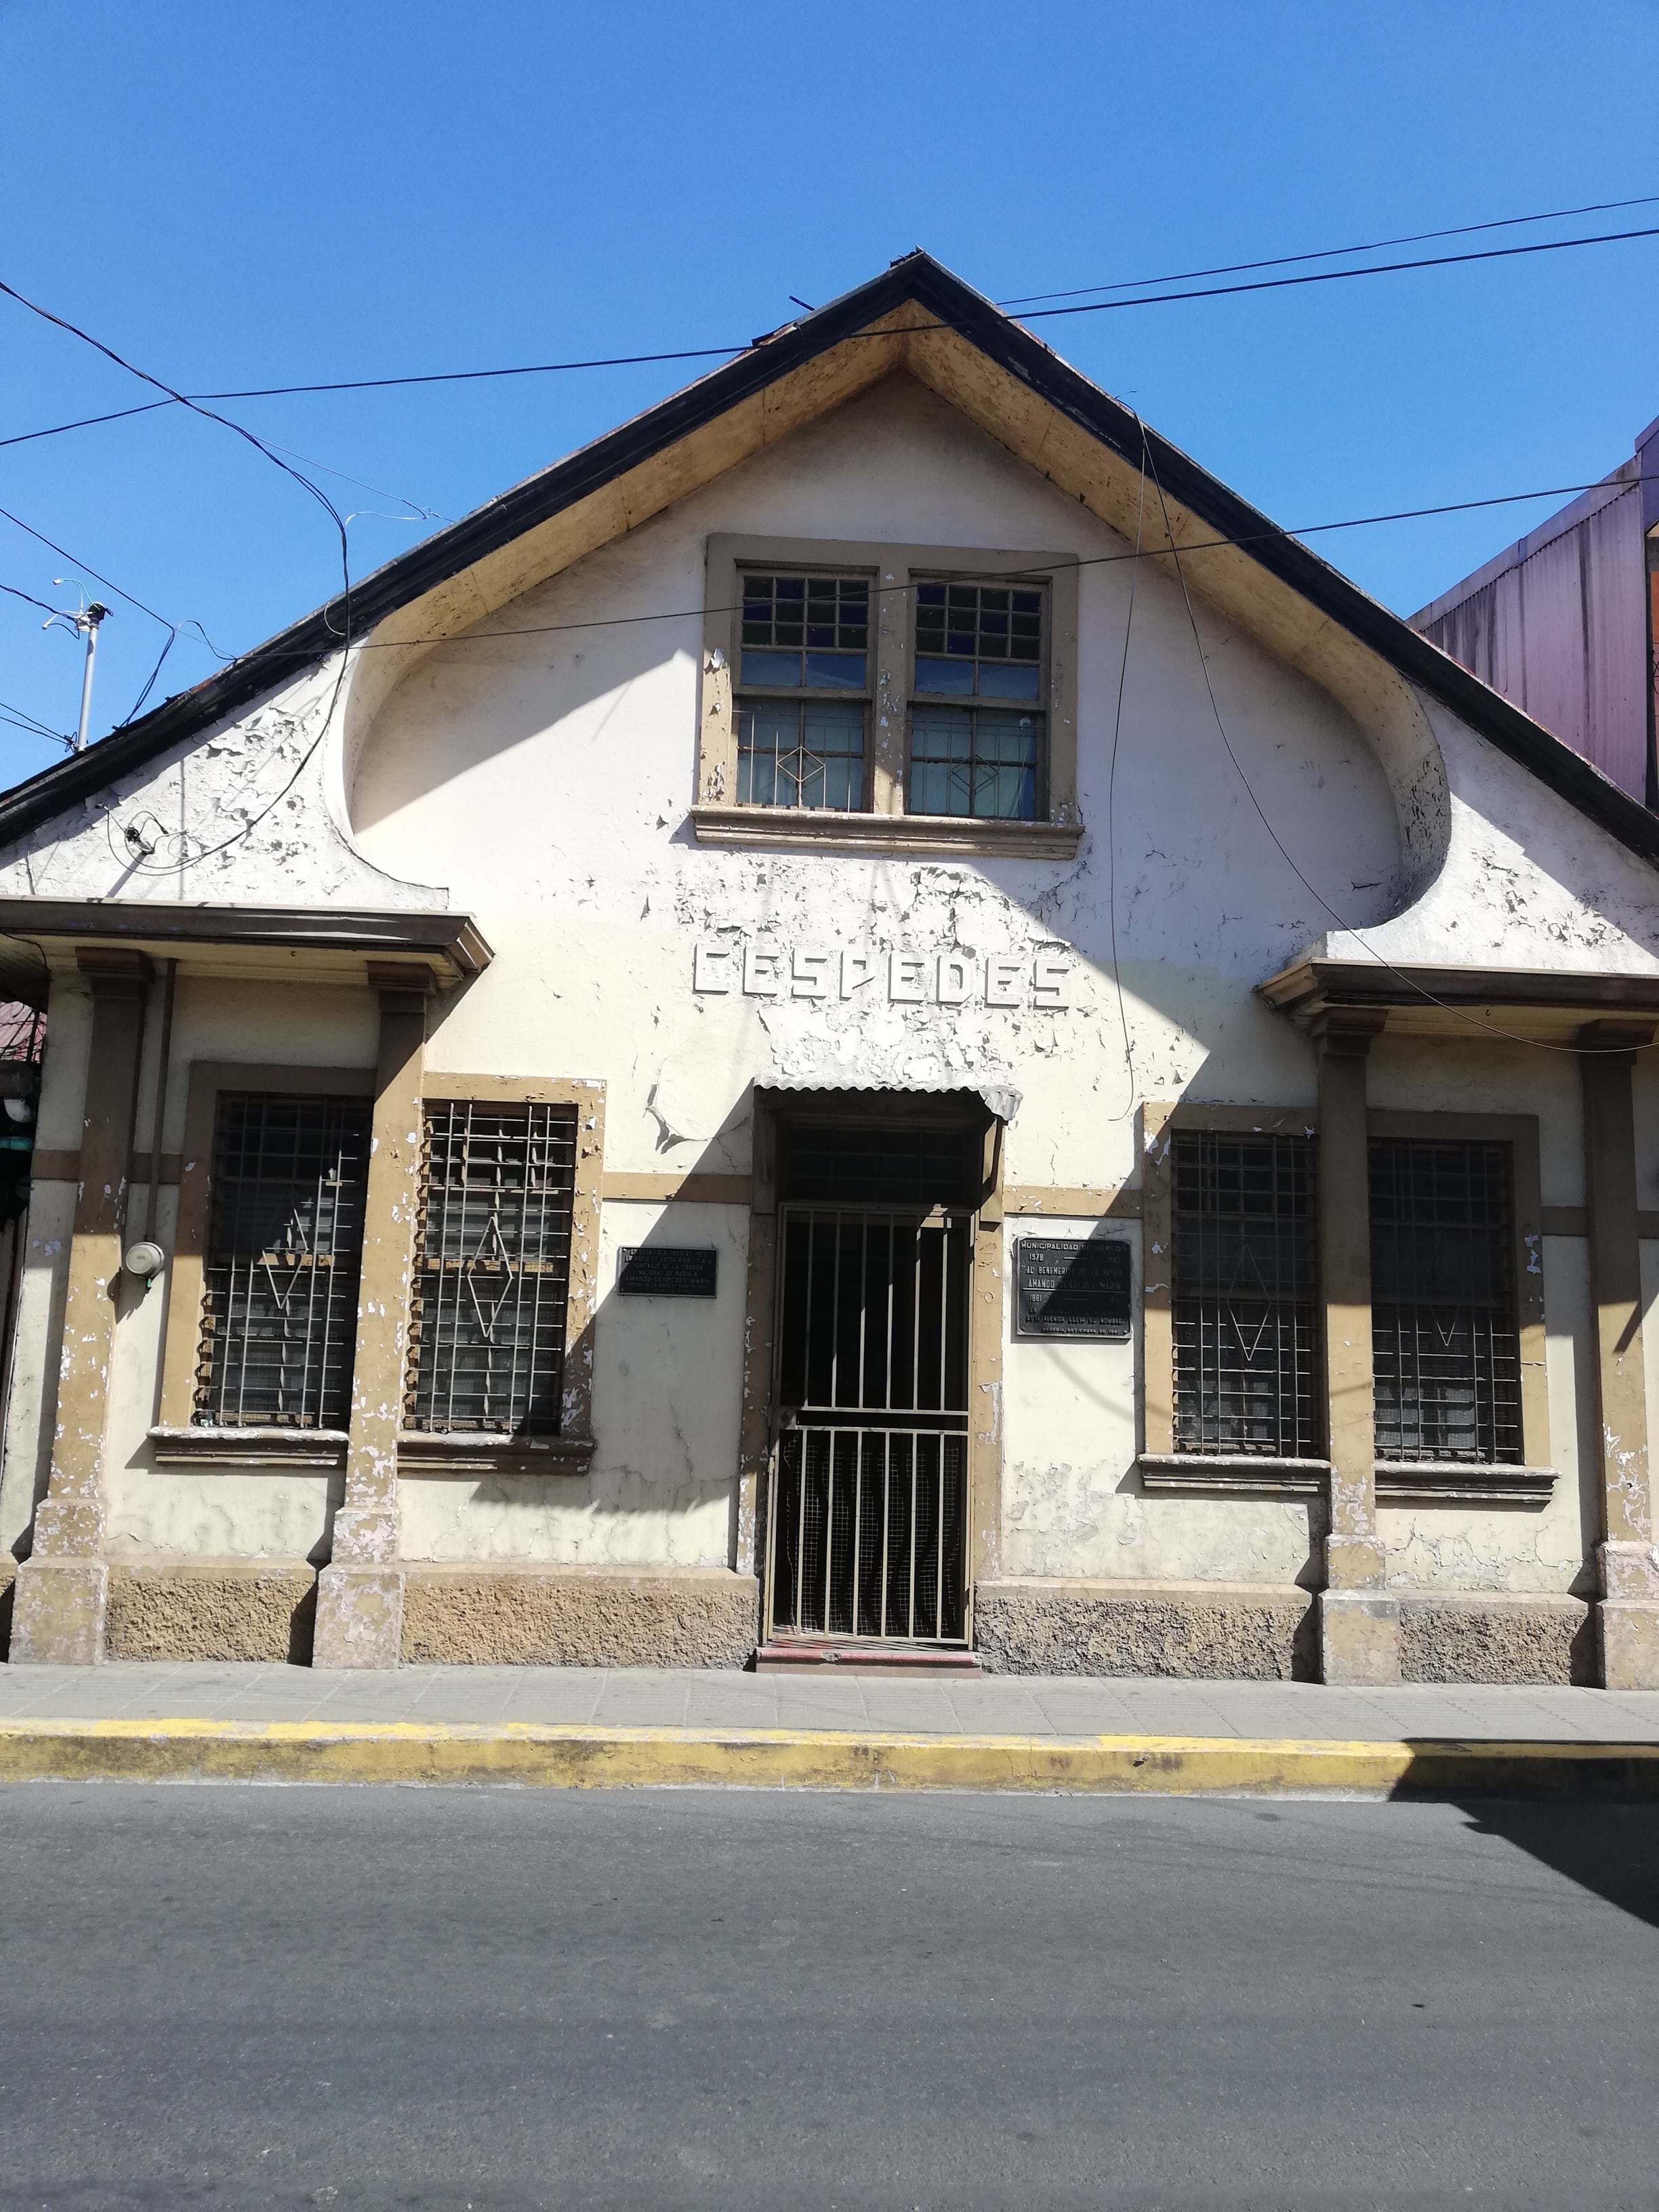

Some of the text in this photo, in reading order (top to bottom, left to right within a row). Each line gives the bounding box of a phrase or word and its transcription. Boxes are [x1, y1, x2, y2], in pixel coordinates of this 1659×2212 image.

[693, 943, 1070, 1009] CESPEDES
[1021, 1242, 1079, 1252] MUNICIPALIDAD
[1029, 1253, 1044, 1261] 1978
[1028, 1279, 1055, 1288] AMANDO
